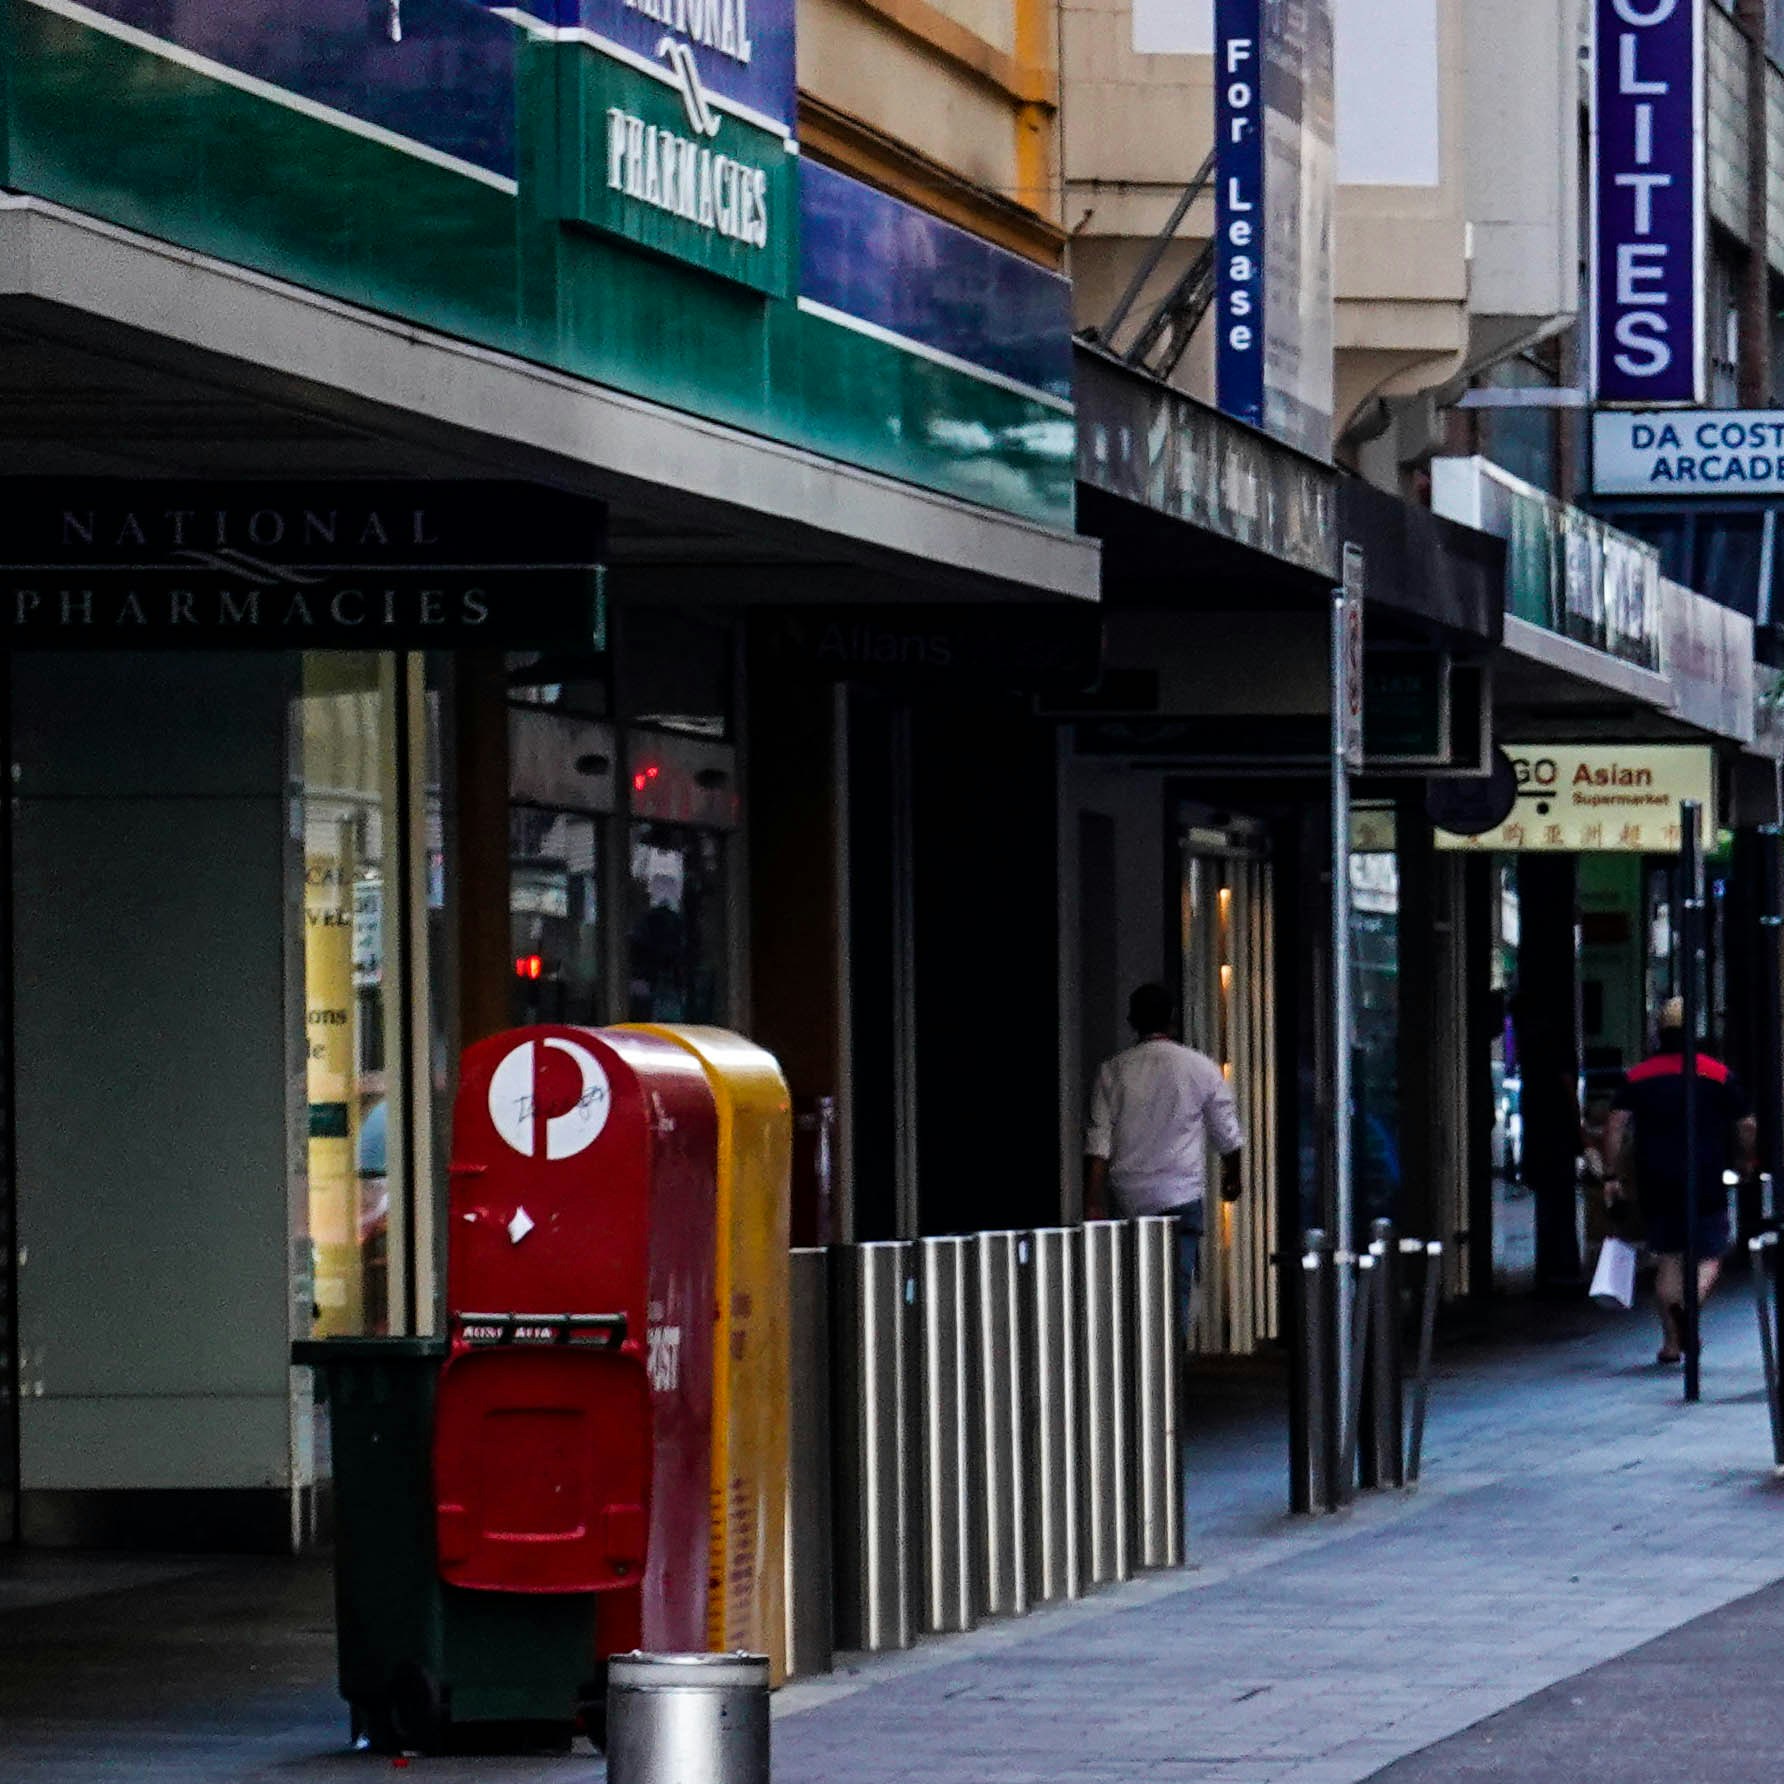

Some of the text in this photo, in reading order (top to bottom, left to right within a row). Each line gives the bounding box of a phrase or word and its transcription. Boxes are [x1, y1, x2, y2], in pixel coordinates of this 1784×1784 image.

[606, 106, 768, 249] PHARMACIES
[1225, 36, 1253, 353] For Lease
[1630, 422, 1682, 450] DA
[62, 508, 440, 547] NATIONAL
[15, 588, 491, 626] PHARMACIES
[1572, 762, 1653, 788] Asian
[1572, 792, 1670, 807] Supermarket
